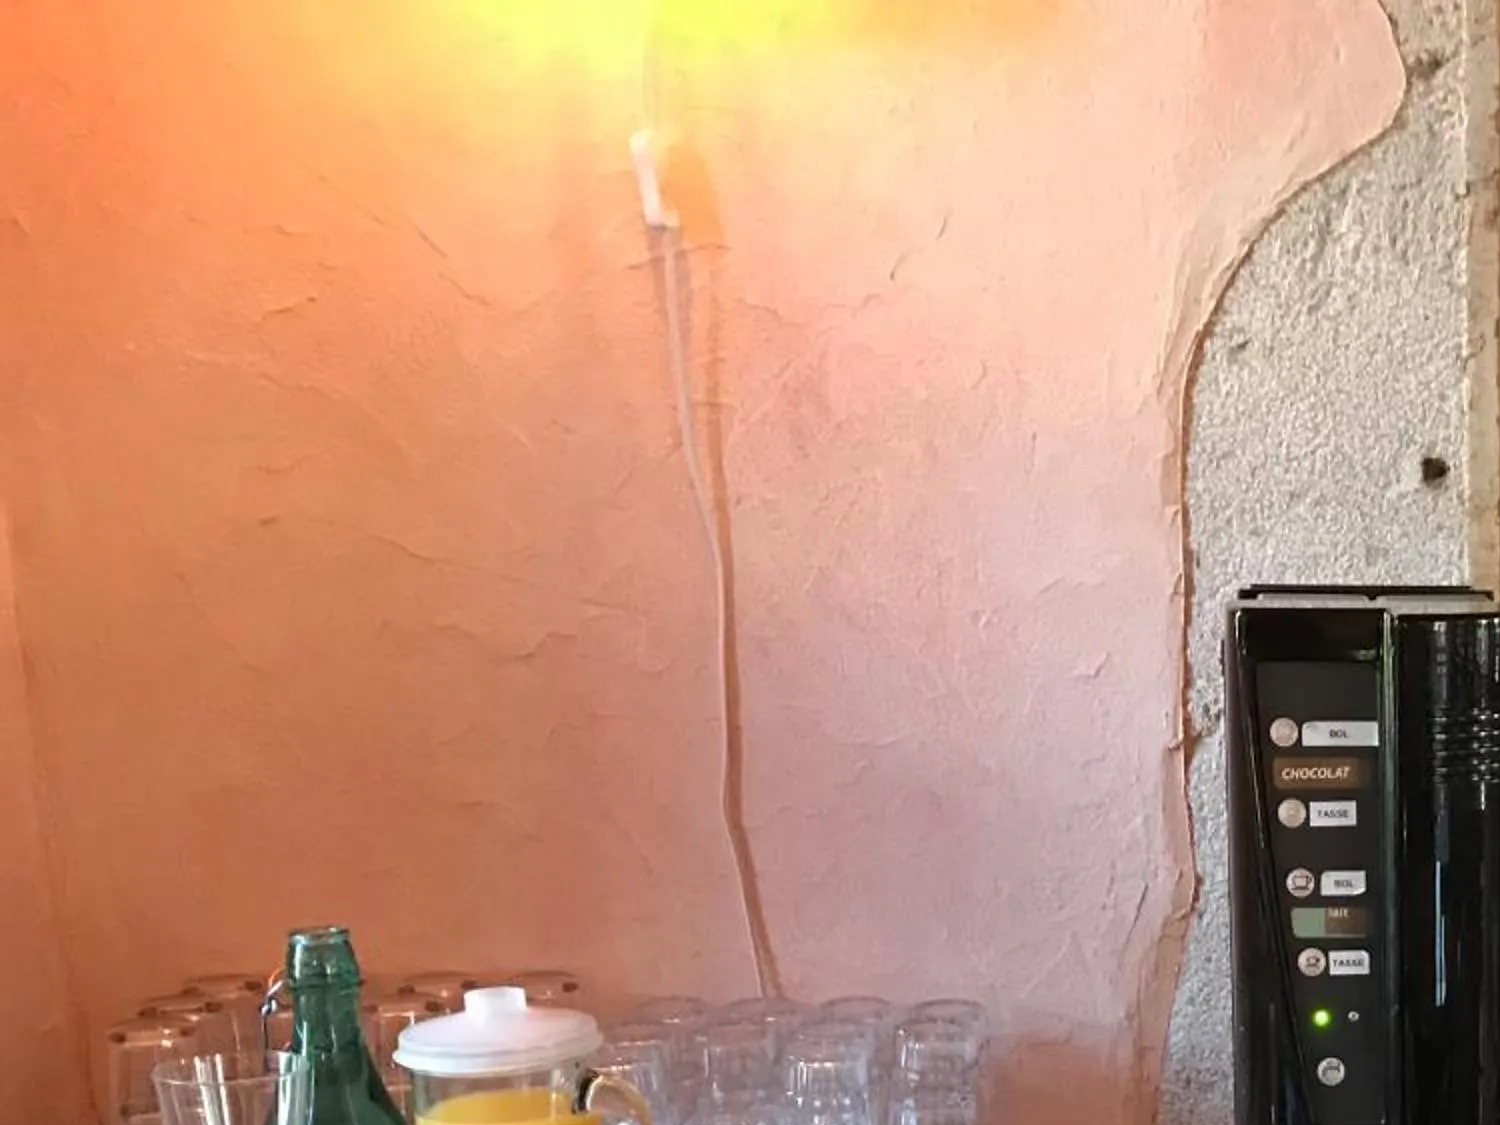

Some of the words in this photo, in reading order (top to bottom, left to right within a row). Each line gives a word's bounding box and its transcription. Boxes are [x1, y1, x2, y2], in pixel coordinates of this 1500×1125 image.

[1329, 729, 1349, 739] BOL
[1281, 766, 1351, 780] CHOCOLAT
[1317, 809, 1349, 818] TASSE
[1332, 959, 1365, 968] TASSE
